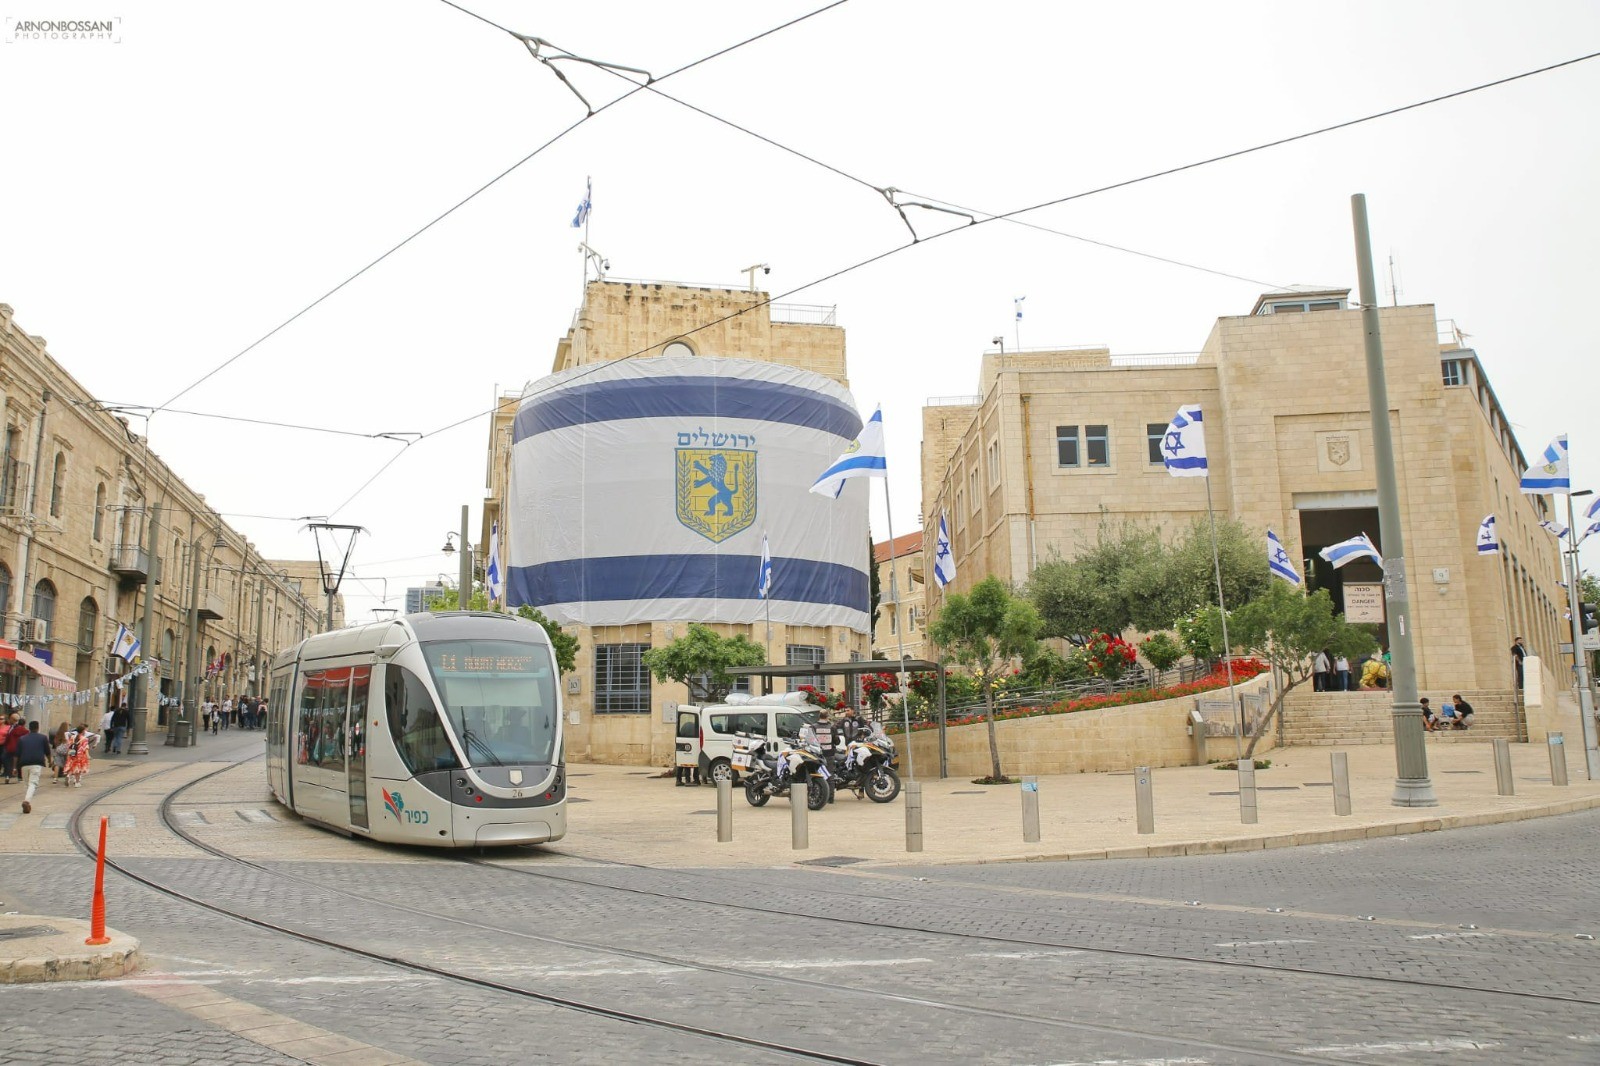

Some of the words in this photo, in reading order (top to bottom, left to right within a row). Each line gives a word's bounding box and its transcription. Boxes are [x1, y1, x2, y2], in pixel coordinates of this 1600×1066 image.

[677, 426, 756, 448] ירושלים
[570, 681, 578, 689] 10
[512, 789, 523, 798] 26
[404, 810, 429, 824] כפיר
